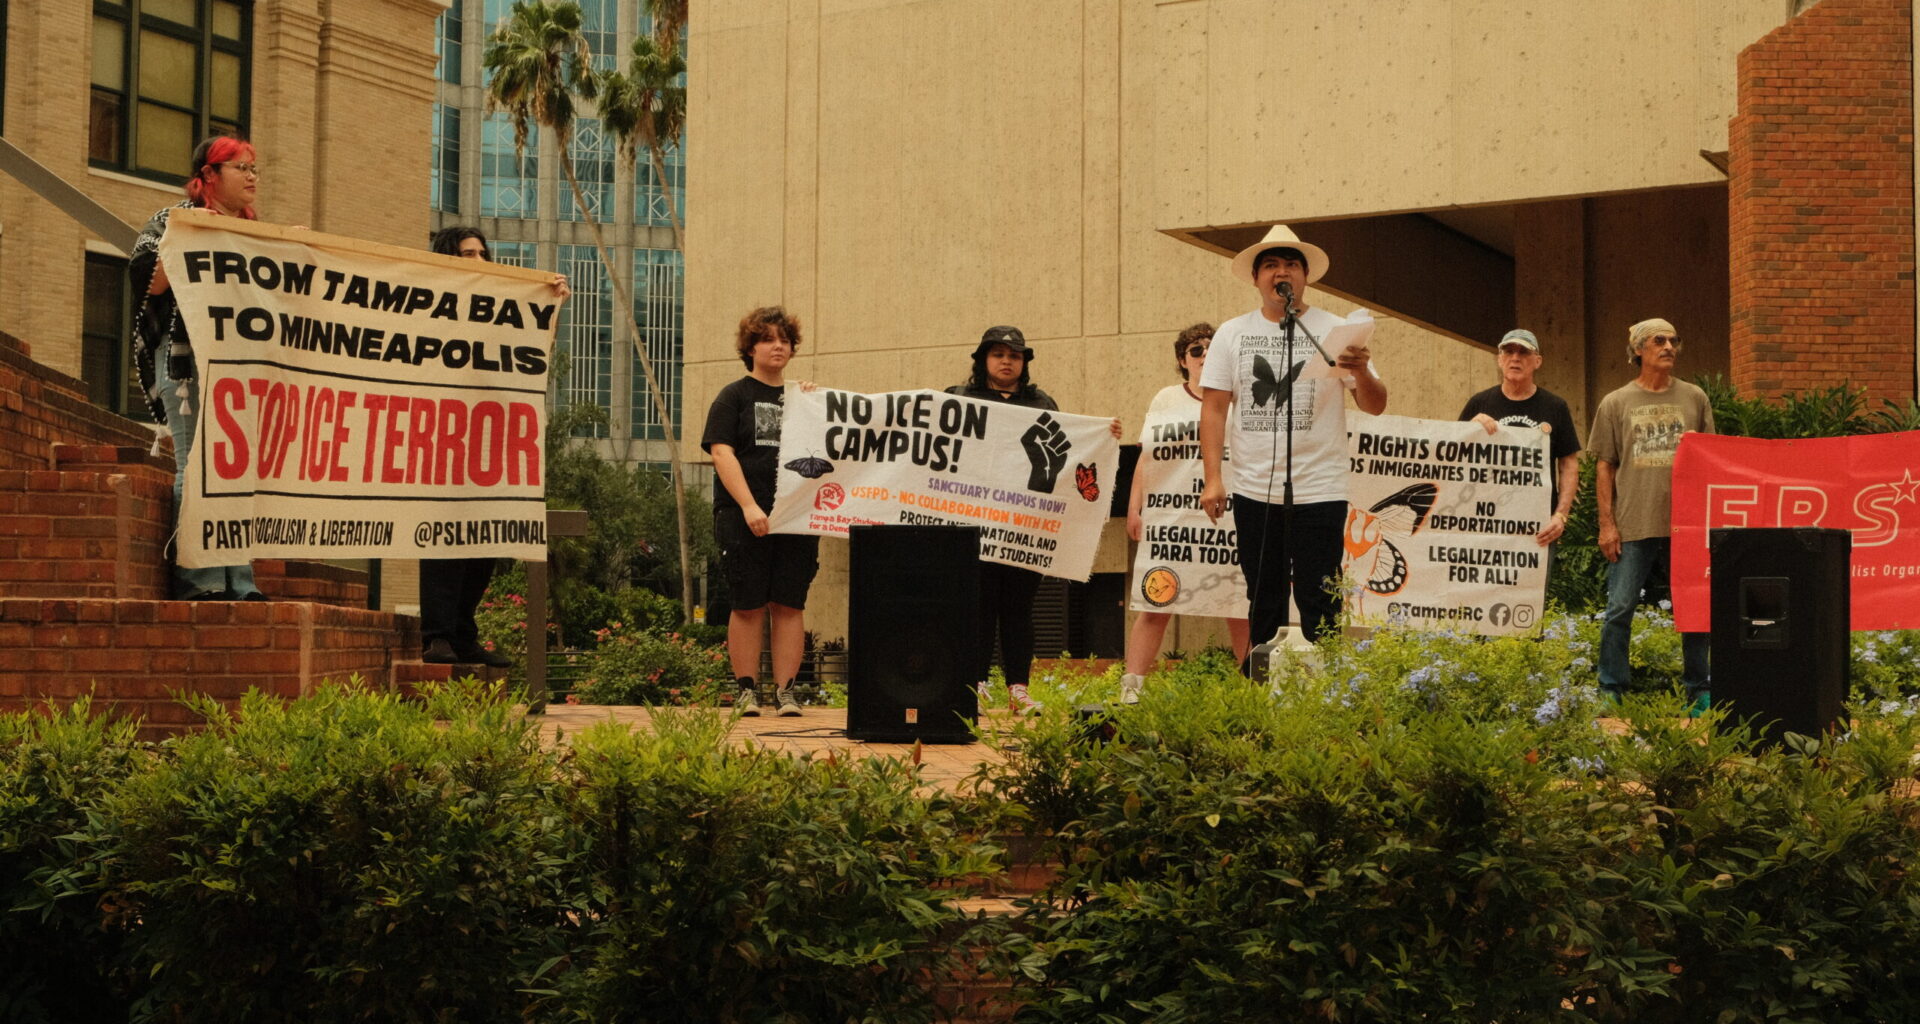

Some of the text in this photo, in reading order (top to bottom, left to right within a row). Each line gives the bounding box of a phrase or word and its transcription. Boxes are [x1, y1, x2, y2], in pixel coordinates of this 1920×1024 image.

[183, 250, 556, 331] FROM TAMPA BAY
[208, 306, 547, 375] TO MINNEAPOLIS
[212, 377, 540, 487] STOP ICE TERROR
[826, 391, 988, 440] NO ICE ON
[825, 425, 963, 474] CAMPUS!
[1152, 420, 1544, 469] TAM RIGHTS COMMITTEE
[1368, 459, 1464, 482] INMIGRANTES
[1469, 467, 1488, 483] DE
[1492, 469, 1543, 487] TAMPA
[851, 486, 889, 501] USFPD
[899, 491, 915, 504] NO
[918, 495, 1009, 524] COLLABORATION
[1013, 512, 1041, 529] WITH
[928, 477, 1067, 515] SANCTUARY CAMPUS NOW!
[1475, 501, 1496, 517] NO
[202, 519, 251, 550] PART
[254, 517, 307, 546] SOCIALISM
[309, 521, 318, 546] &
[320, 519, 394, 546] LIBERATION
[1430, 515, 1541, 536] DEPORTATIONS!
[999, 547, 1053, 568] STUDENTS!
[1036, 537, 1057, 552] AND
[1150, 543, 1241, 566] PARA TODO
[1428, 545, 1539, 569] LEGALIZATION
[1449, 566, 1518, 586] FOR ALL!
